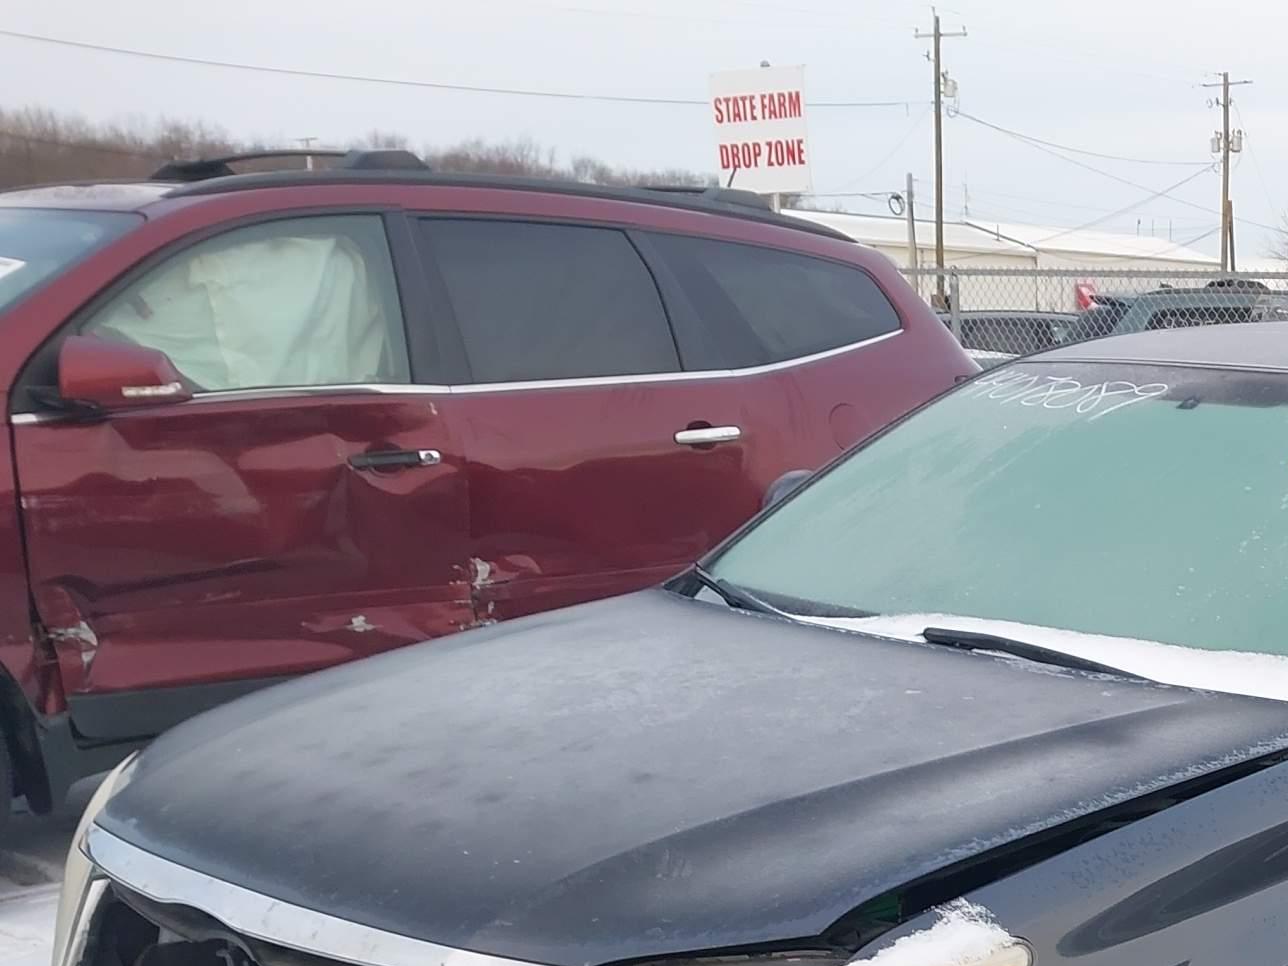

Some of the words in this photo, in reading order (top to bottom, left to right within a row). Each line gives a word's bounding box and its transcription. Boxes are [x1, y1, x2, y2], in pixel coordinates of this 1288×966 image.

[714, 95, 757, 123] STATE
[760, 91, 801, 120] FARM
[719, 142, 762, 170] DROP
[766, 138, 806, 167] ZONE
